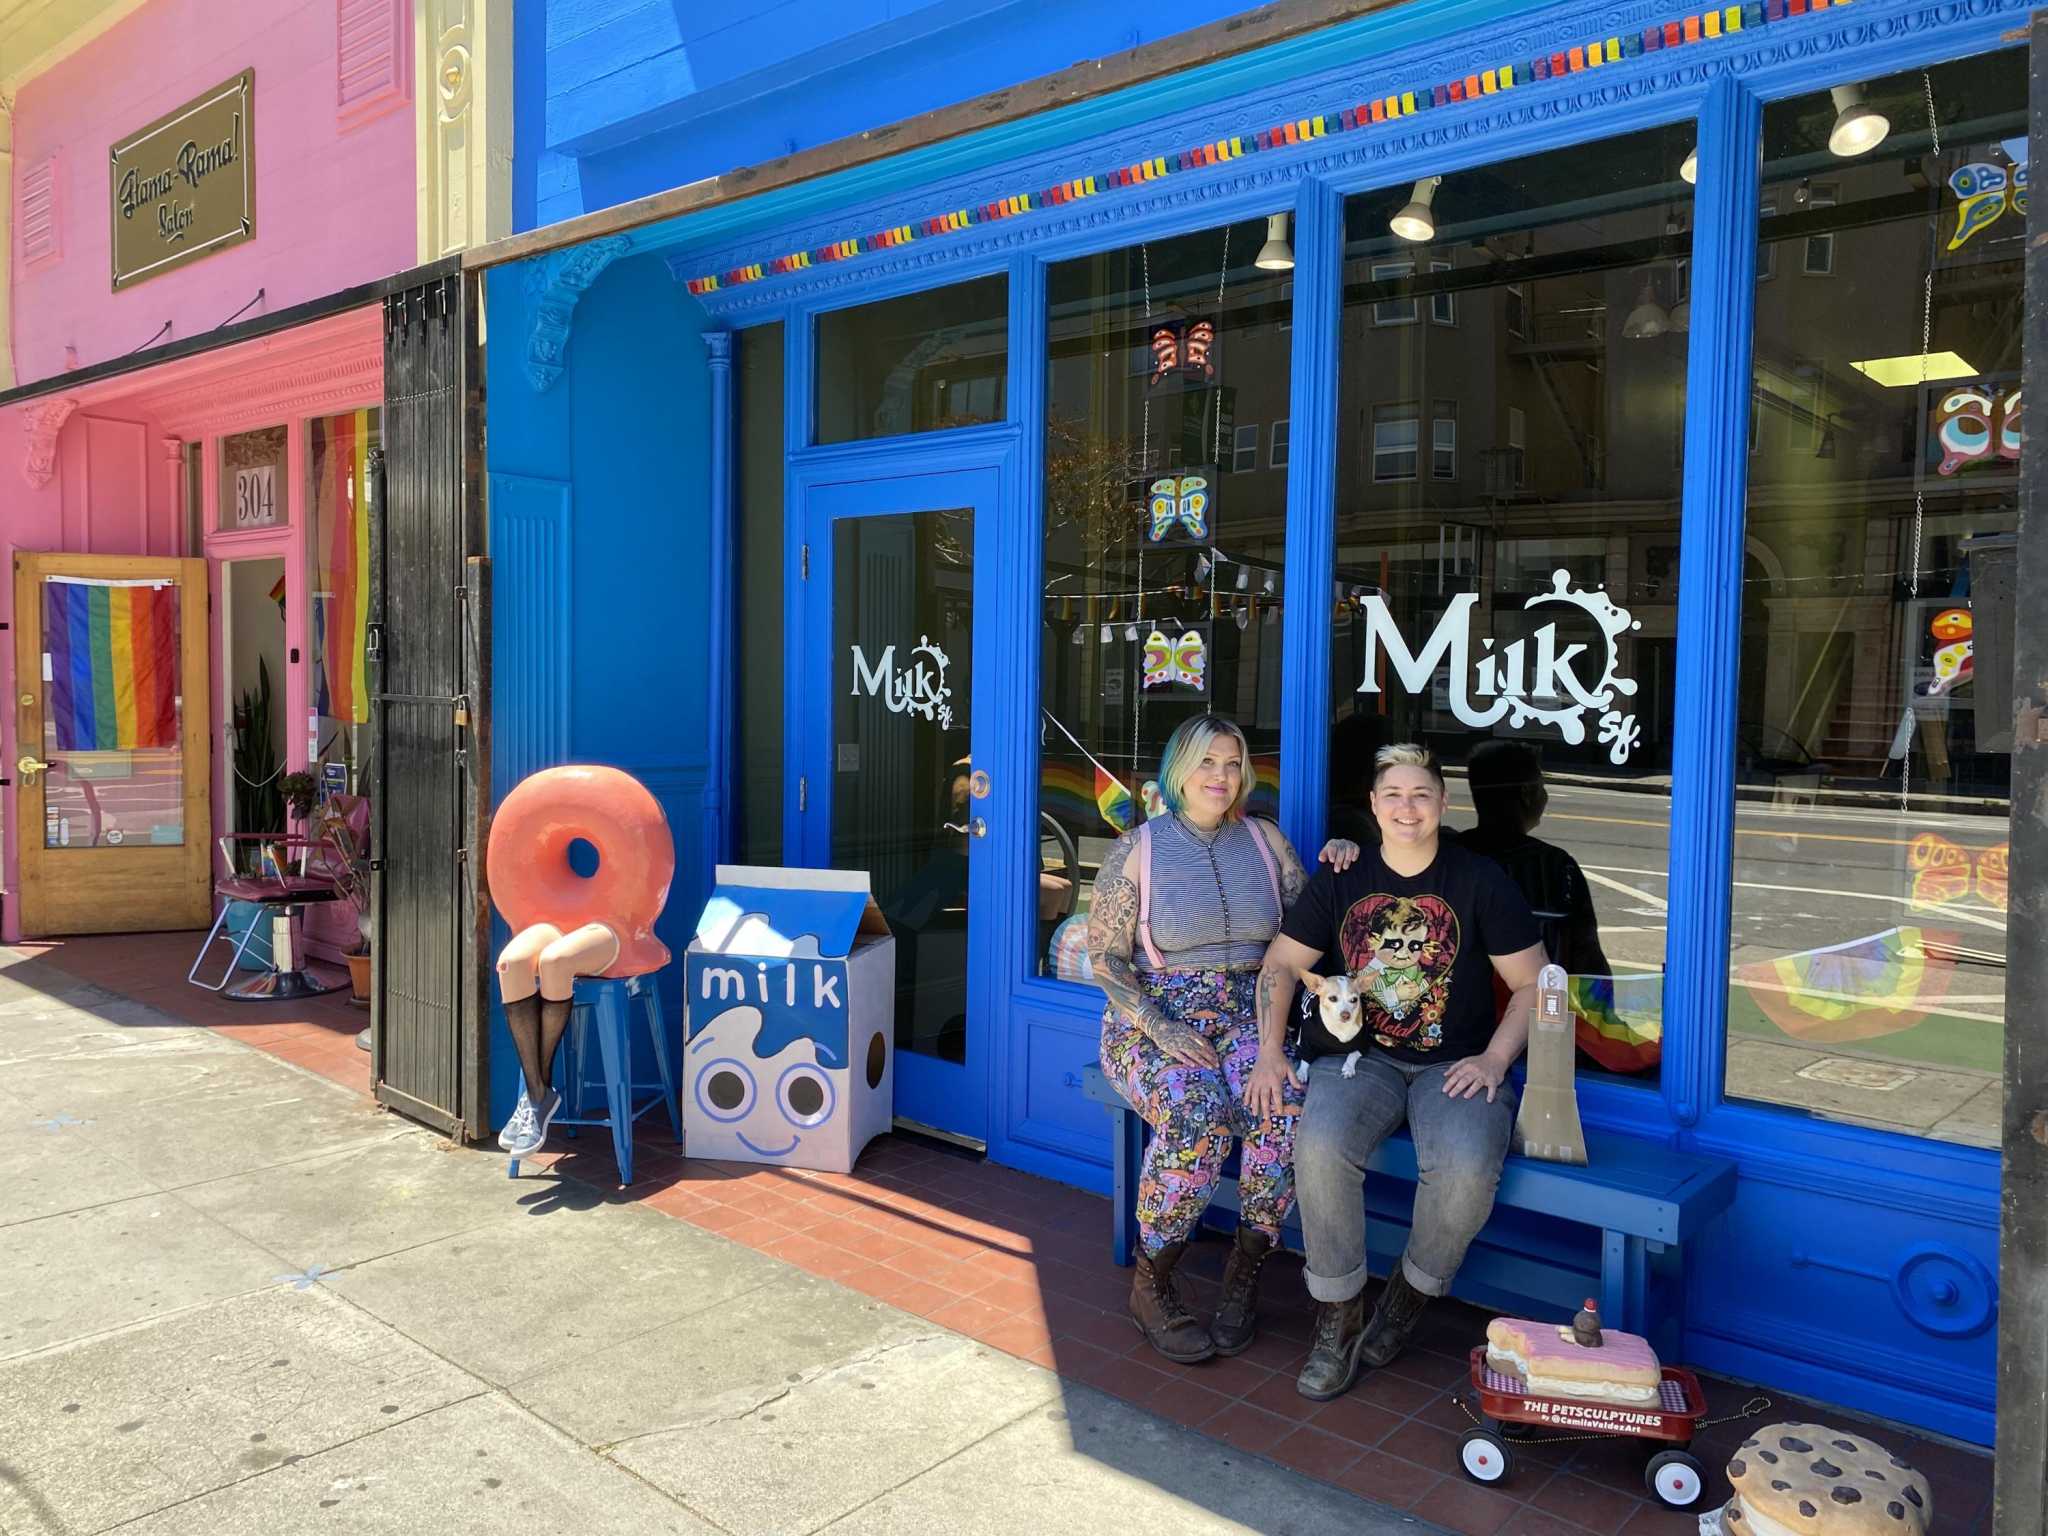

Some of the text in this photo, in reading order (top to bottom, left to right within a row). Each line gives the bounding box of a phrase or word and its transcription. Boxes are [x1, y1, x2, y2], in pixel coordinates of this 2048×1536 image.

[158, 199, 194, 238] Salon
[238, 471, 274, 521] 304
[850, 644, 944, 713] Milk
[1356, 592, 1615, 728] Milk
[701, 961, 841, 1009] milk
[1368, 1007, 1422, 1038] Metal
[1523, 1400, 1662, 1427] THE PETSCULPTURES
[1551, 1414, 1641, 1434] @CamilaValdezArt
